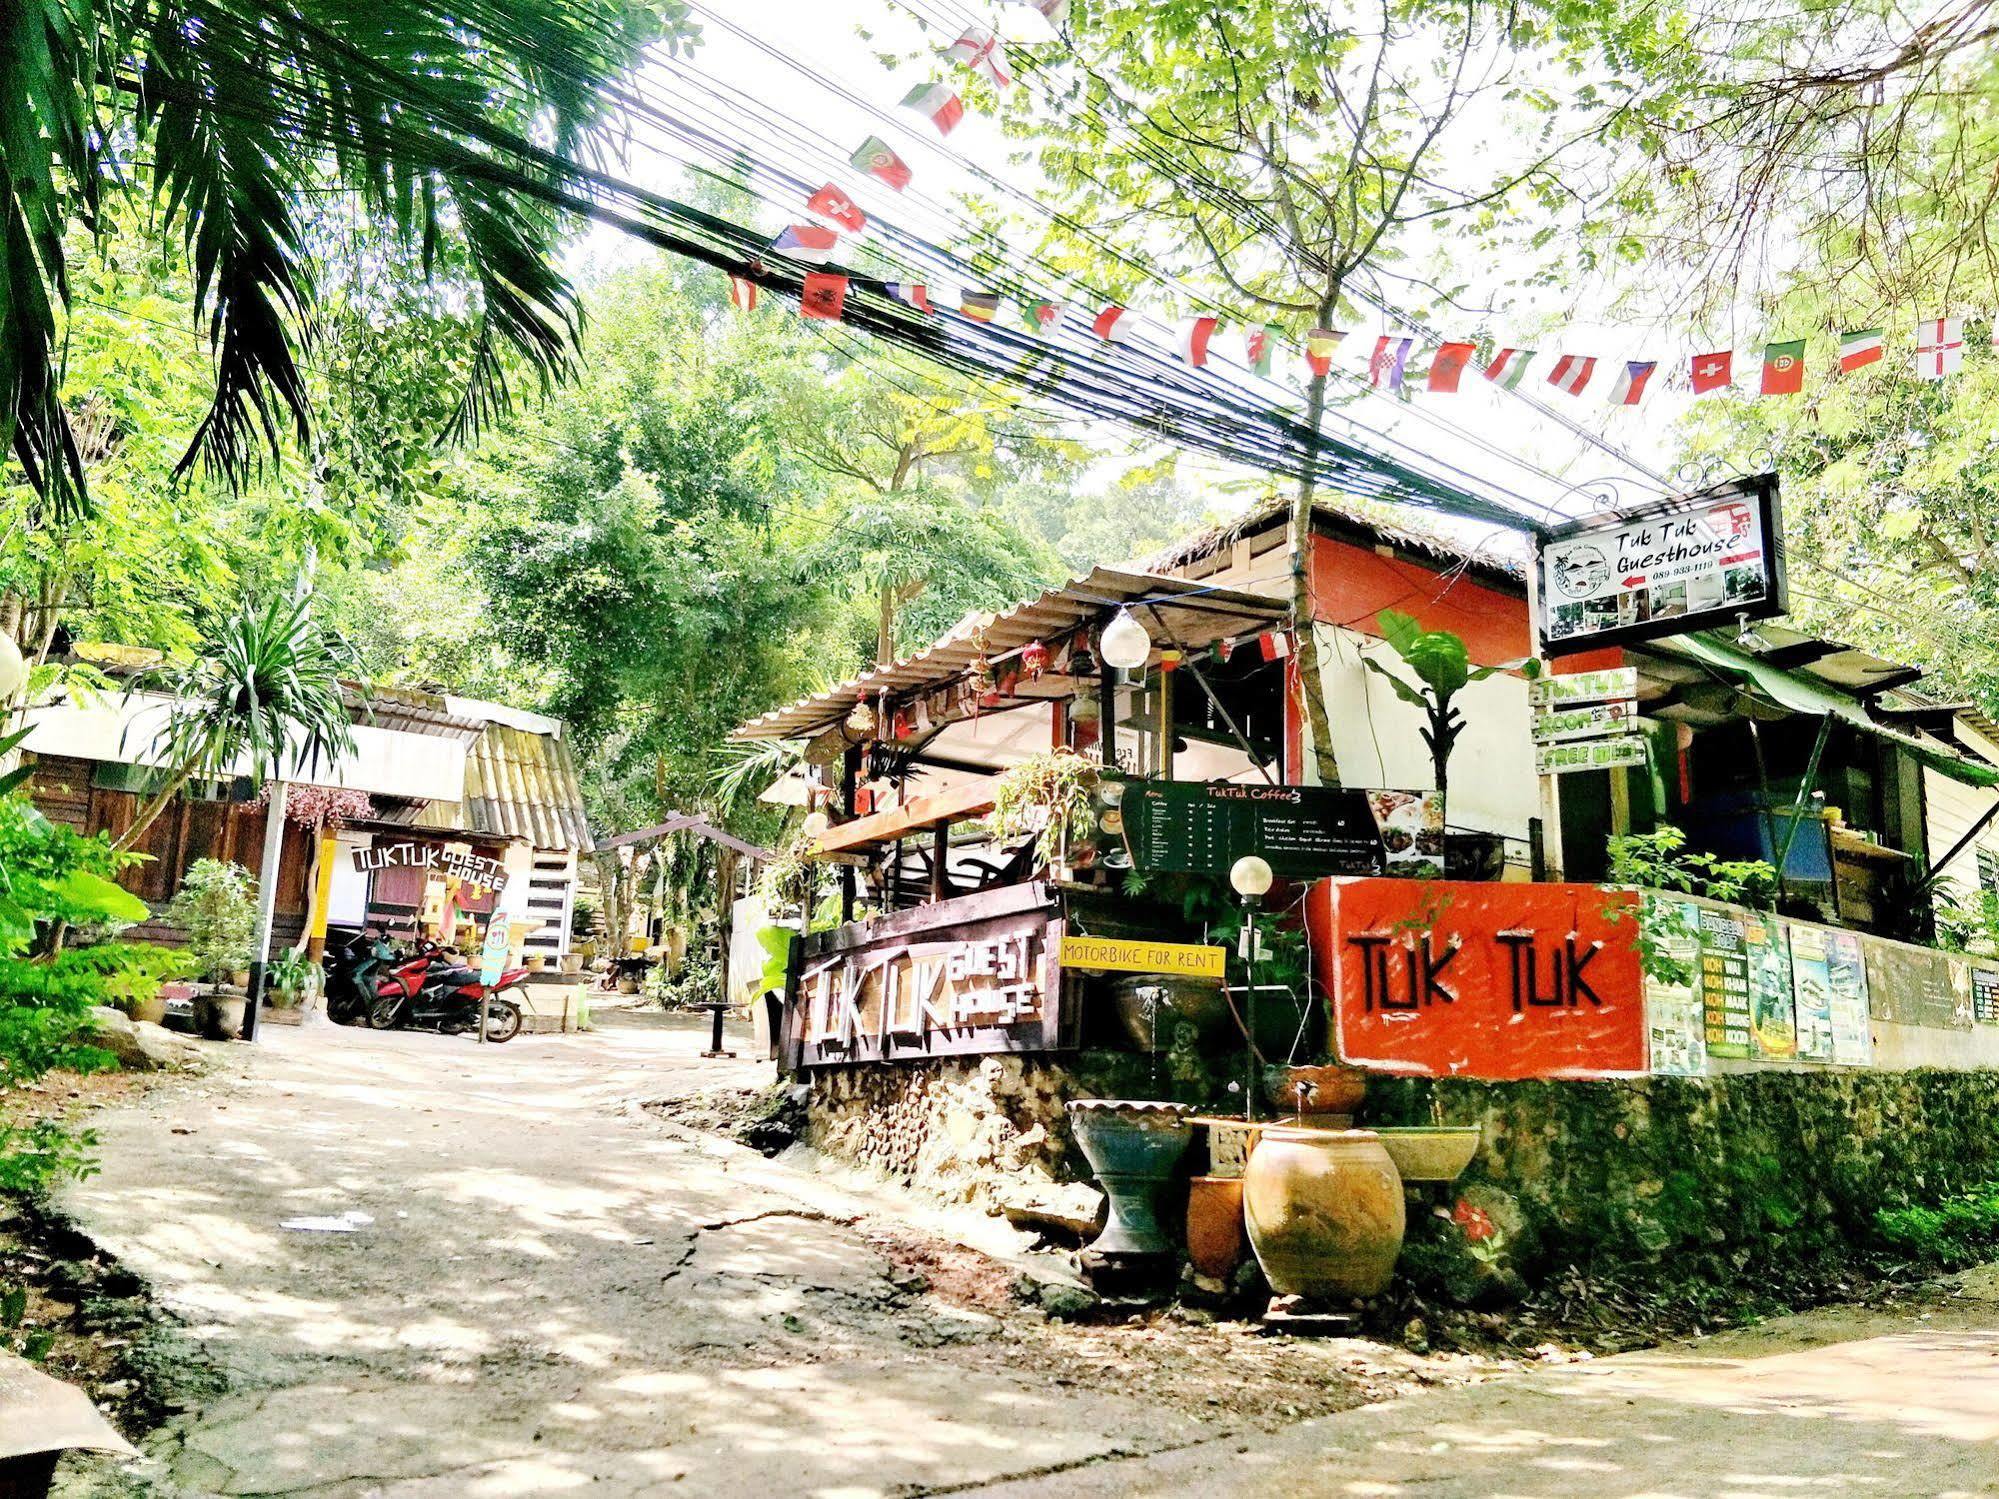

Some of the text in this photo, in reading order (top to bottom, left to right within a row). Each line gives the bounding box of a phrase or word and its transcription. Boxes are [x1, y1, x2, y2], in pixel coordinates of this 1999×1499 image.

[1615, 518, 1697, 552] Tuk Tuk
[1617, 534, 1741, 573] Guesthouse
[1544, 746, 1589, 768] FREE
[1251, 788, 1293, 800] Coffee
[447, 863, 505, 891] HOUSE
[949, 929, 1034, 981] GUEST
[1063, 944, 1218, 968] MOTORBIKE FOR RENT
[1703, 957, 1723, 973] KOH
[1347, 931, 1603, 1013] TUK TUK
[1704, 974, 1724, 990] KOH
[953, 983, 1036, 1024] HOUSE
[1705, 992, 1725, 1009] KOH
[1705, 1010, 1725, 1026] KOH
[1706, 1027, 1725, 1043] KOH
